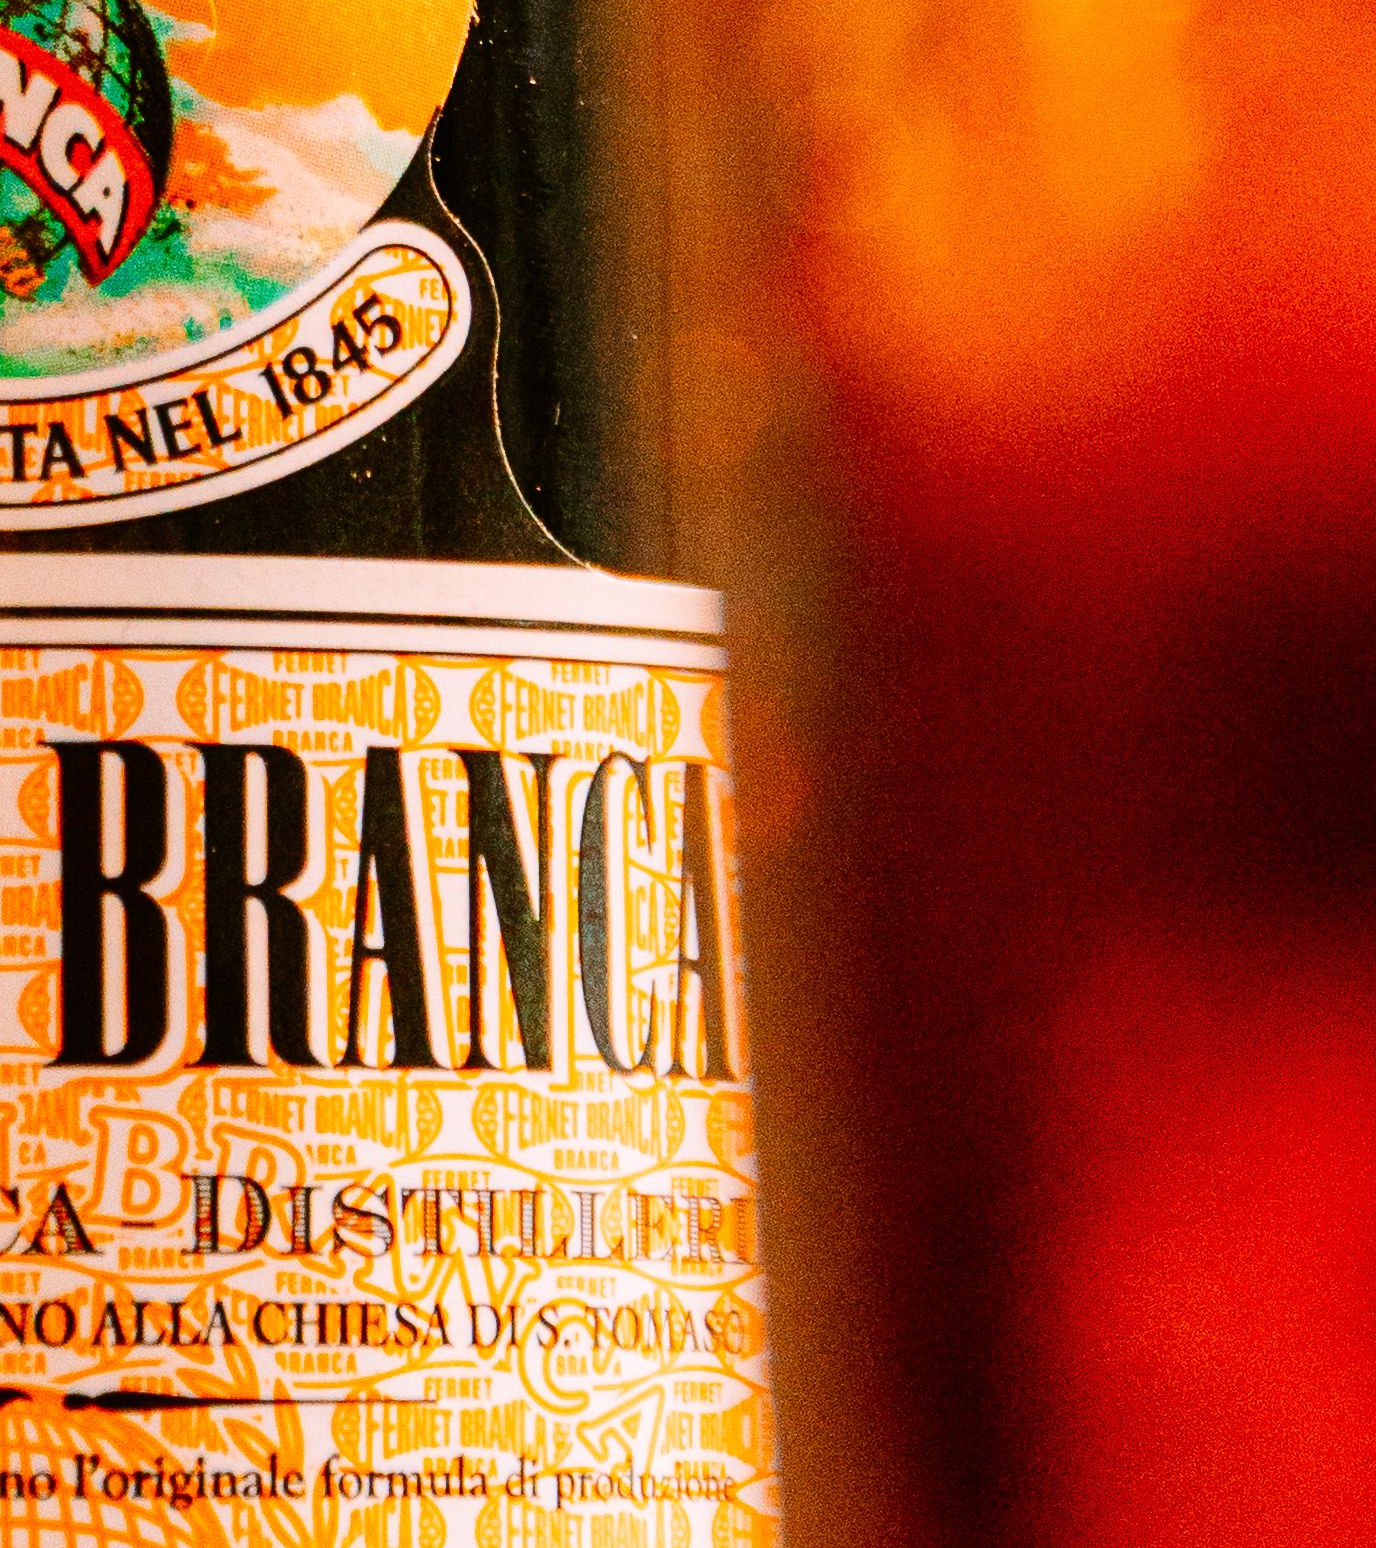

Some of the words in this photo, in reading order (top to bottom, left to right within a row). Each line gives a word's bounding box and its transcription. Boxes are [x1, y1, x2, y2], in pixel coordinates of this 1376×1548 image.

[109, 390, 246, 476] NEL
[256, 292, 408, 421] 1845
[39, 739, 742, 1083] BRANCA
[91, 1300, 238, 1348] ALLA
[252, 1300, 451, 1348] CHIESA
[467, 1302, 521, 1348] DI
[535, 1303, 571, 1349] S.
[584, 1304, 744, 1354] TOMASO
[74, 1451, 305, 1512] l'originale
[321, 1452, 489, 1500] formula
[503, 1454, 539, 1500] di
[554, 1457, 737, 1510] produzione
